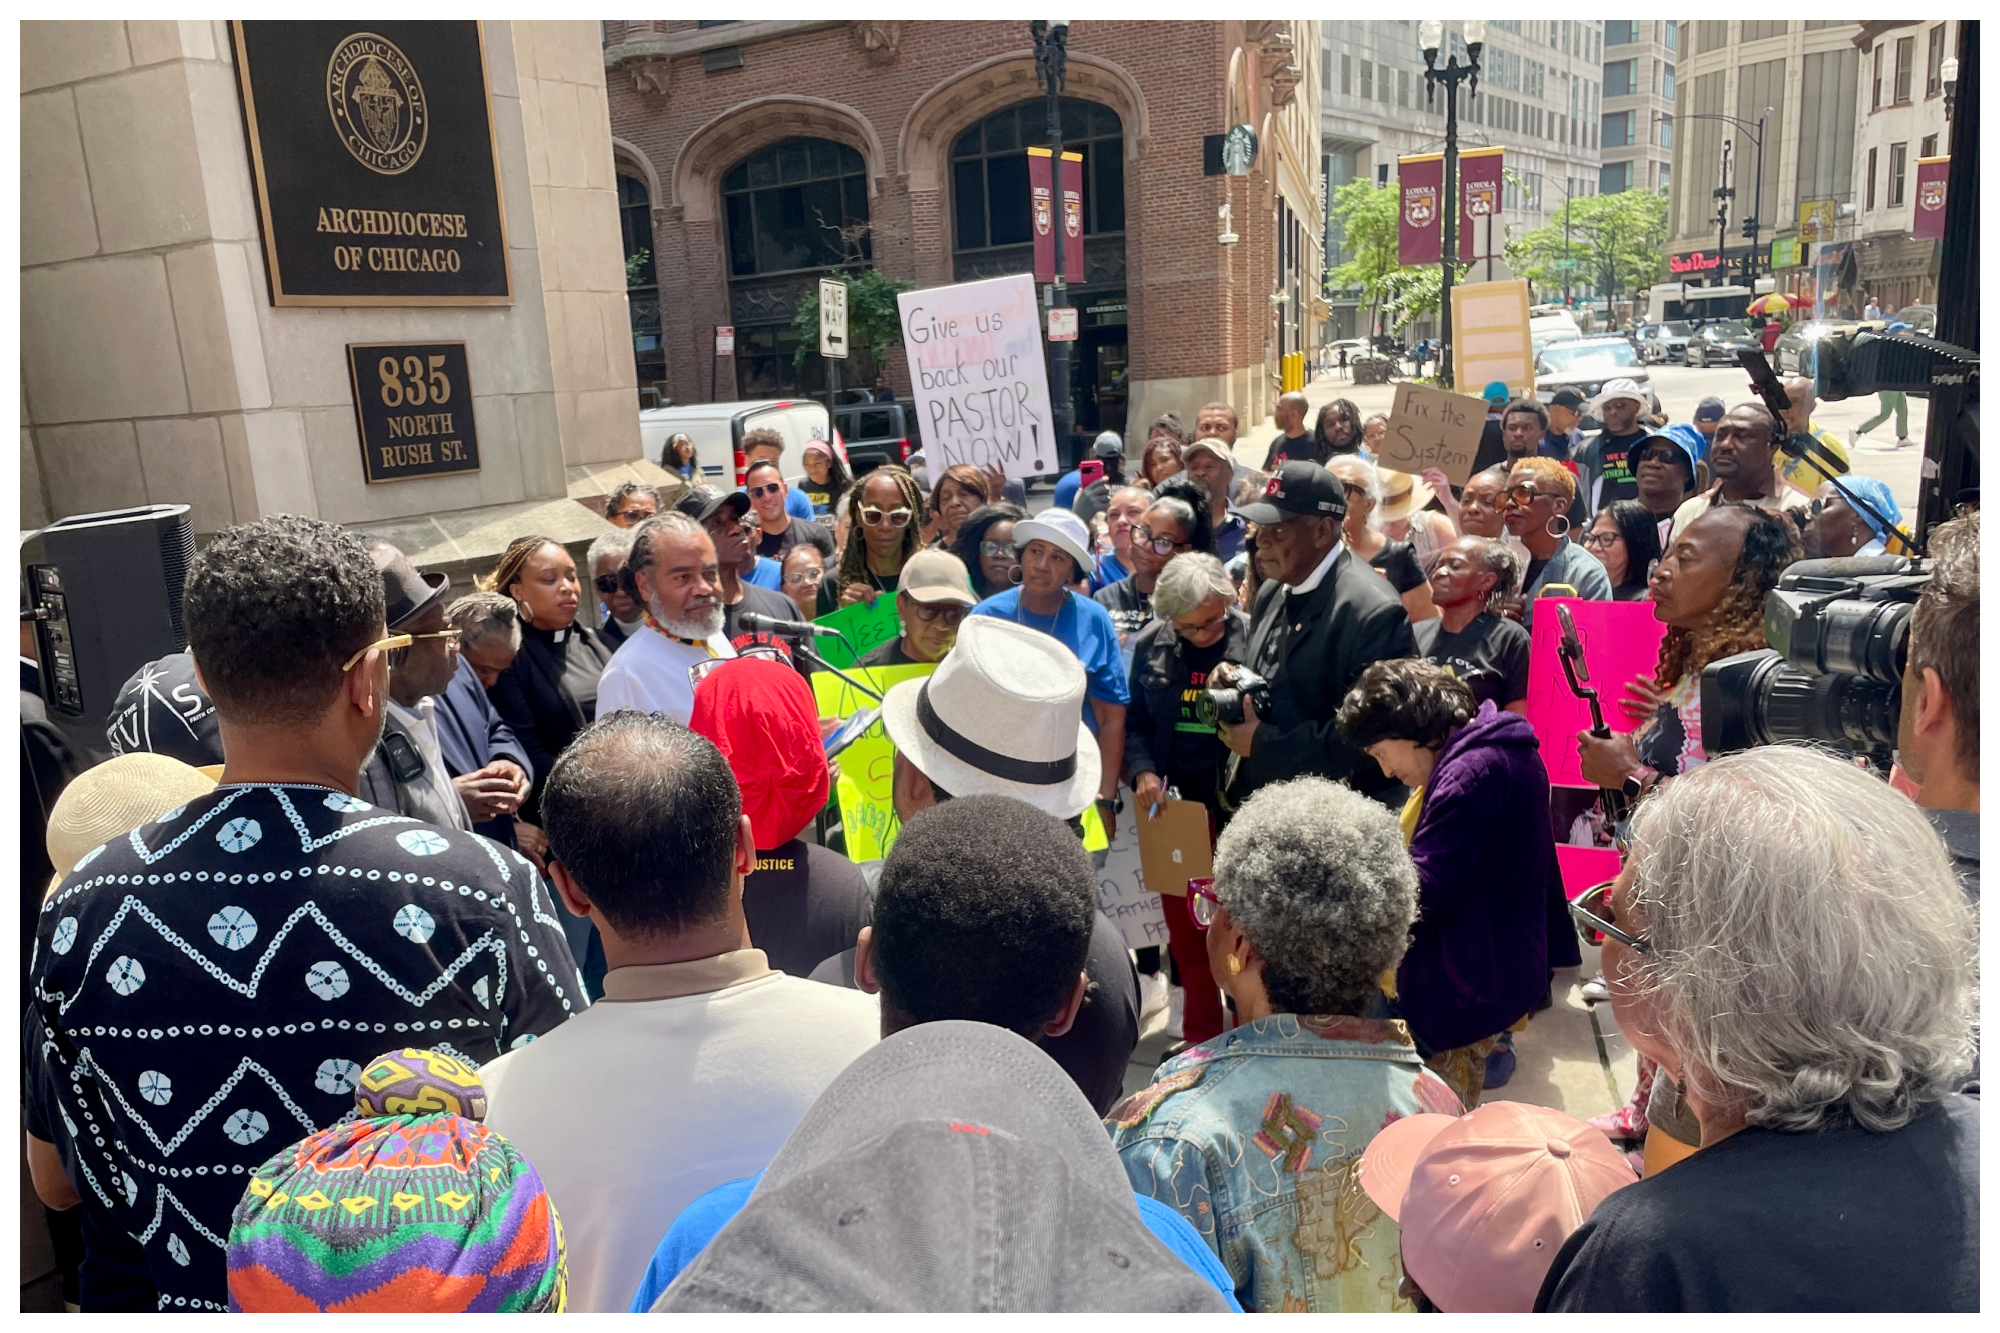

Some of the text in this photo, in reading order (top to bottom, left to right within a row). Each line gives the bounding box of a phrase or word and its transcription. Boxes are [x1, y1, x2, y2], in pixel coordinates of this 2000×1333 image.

[331, 40, 422, 112] ARCHDIOCESE OF
[349, 135, 417, 169] CHICAGO
[1405, 186, 1436, 197] LOYOLA
[1465, 180, 1496, 191] LOYOLA
[316, 206, 468, 238] ARCHDIOCESE
[333, 245, 461, 273] OF CHICAGO
[823, 287, 842, 307] ONE
[823, 308, 843, 327] WAY
[907, 307, 1004, 344] Give us
[378, 354, 451, 408] 835
[917, 349, 1018, 390] back our
[929, 381, 1041, 439] PASTOR
[1403, 390, 1467, 428] Fix the
[386, 412, 455, 439] NORTH
[380, 440, 468, 468] RUSH ST.
[1389, 425, 1469, 471] System
[754, 858, 795, 870] USTICE
